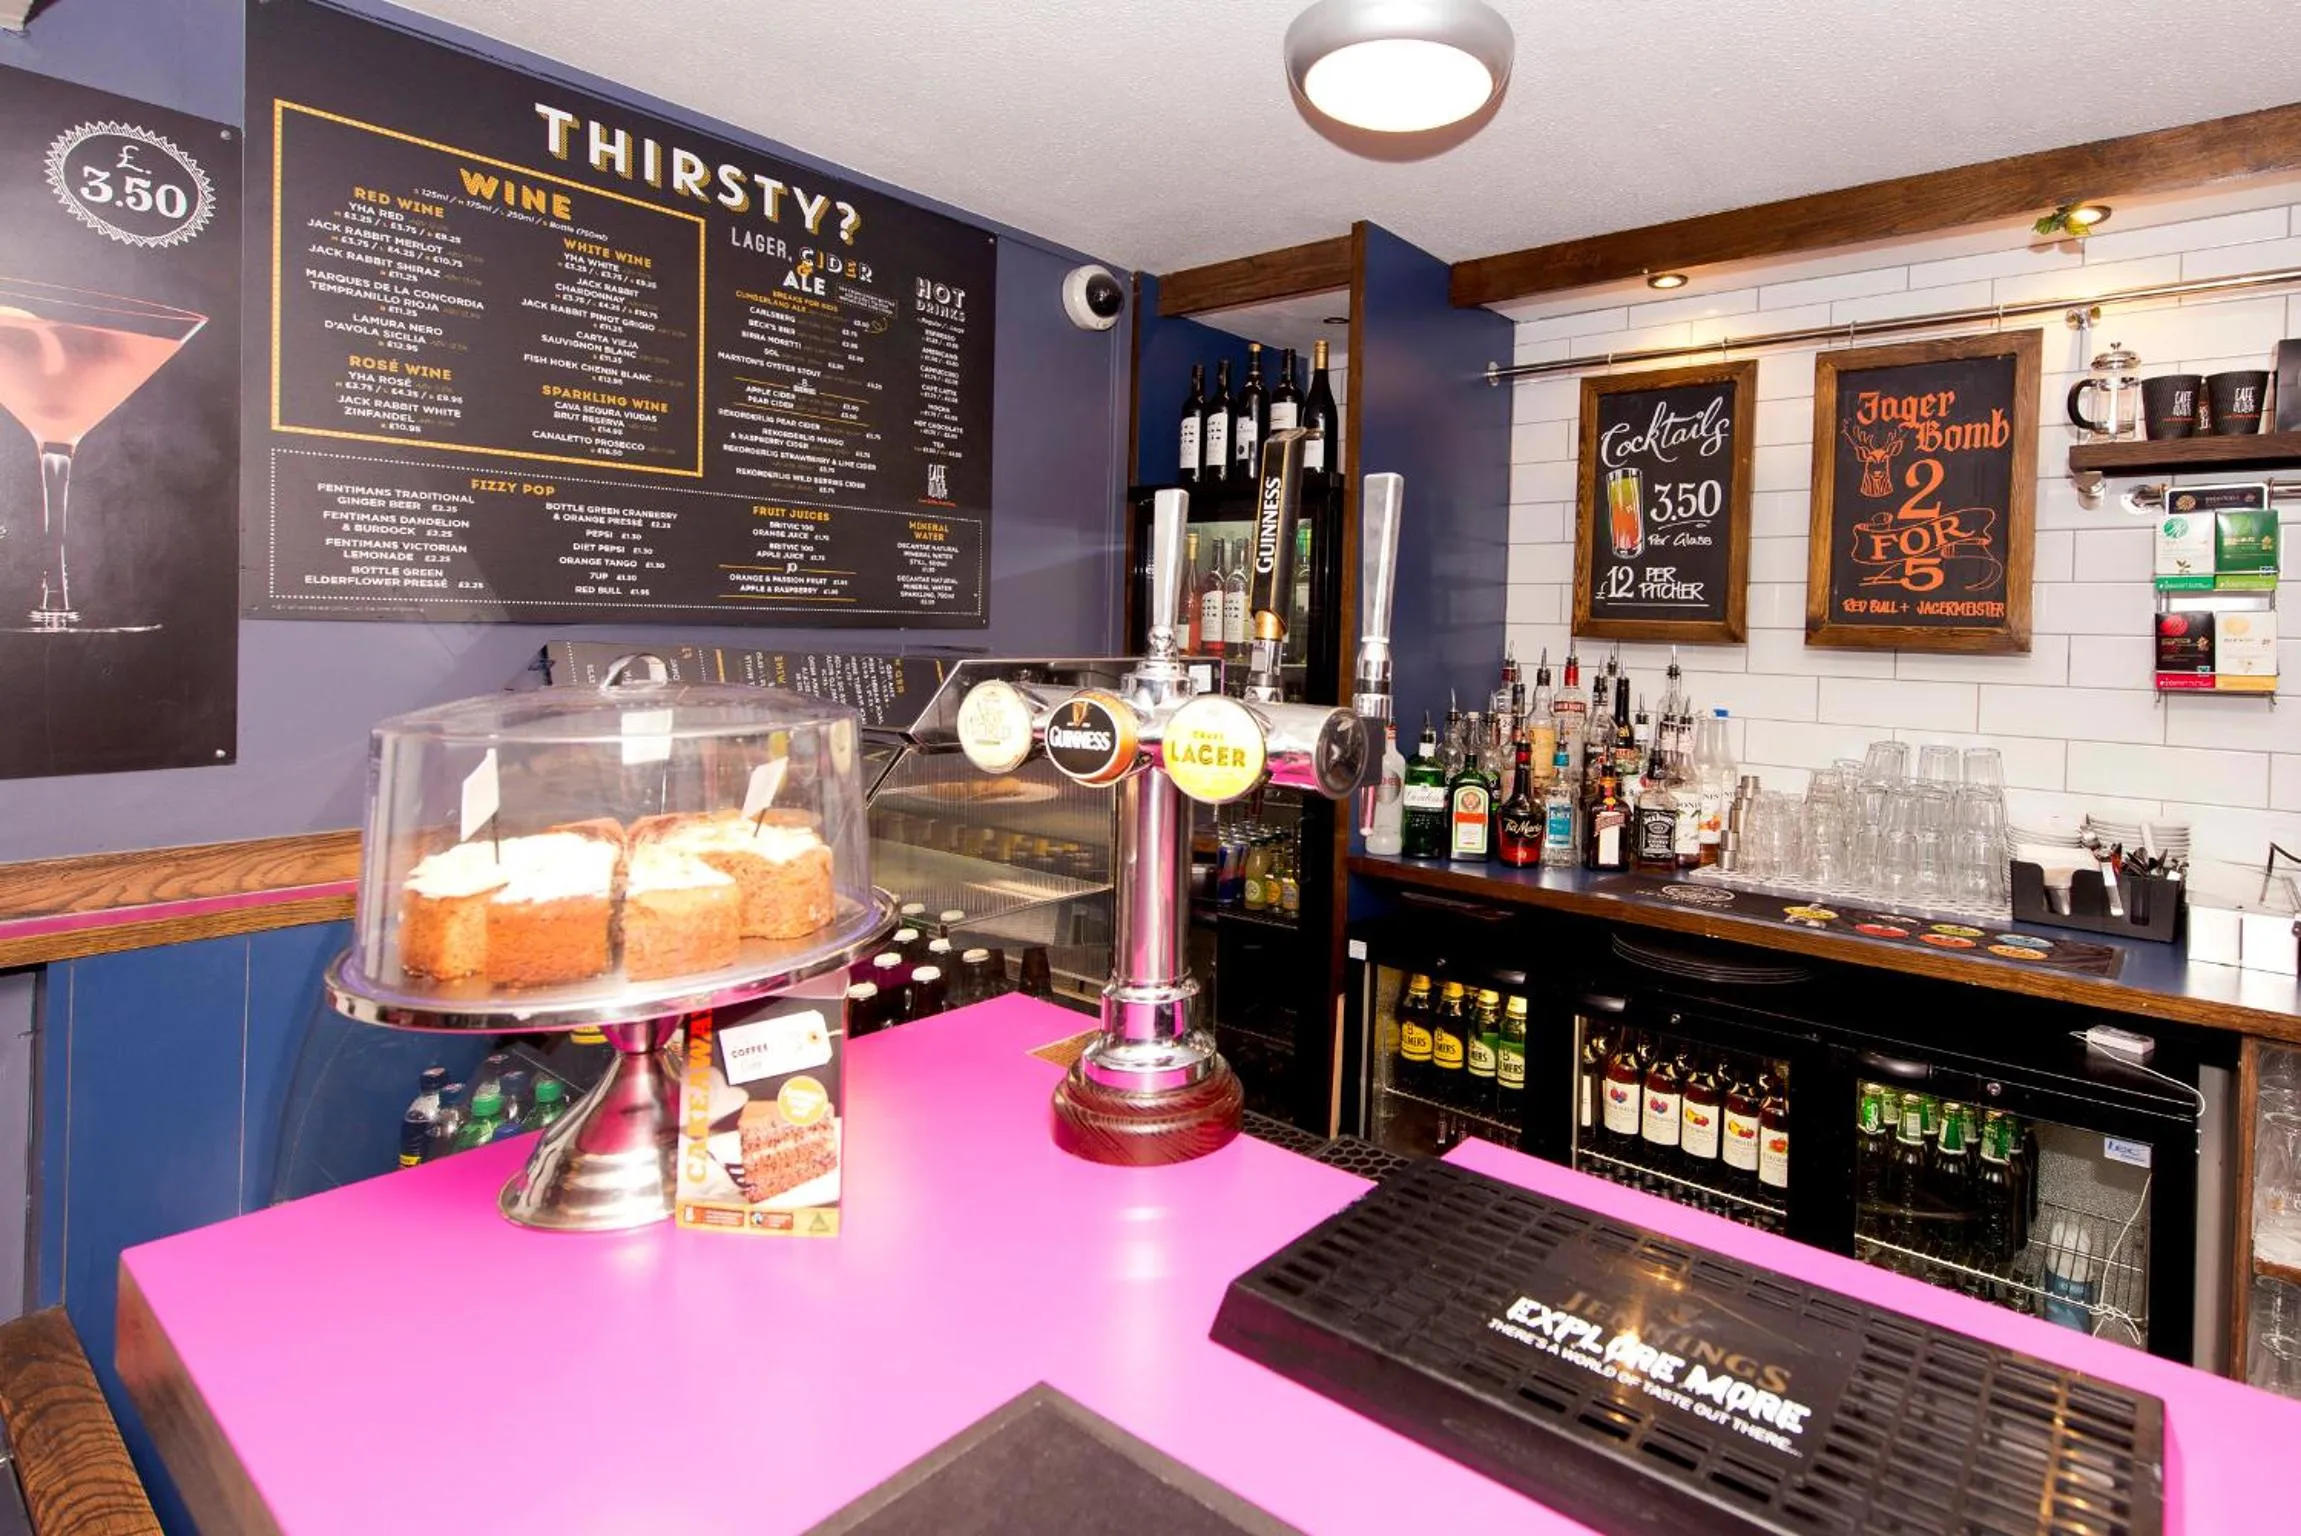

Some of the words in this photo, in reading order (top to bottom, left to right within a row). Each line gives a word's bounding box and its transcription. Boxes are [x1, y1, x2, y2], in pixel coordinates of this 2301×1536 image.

[116, 145, 152, 174] £
[534, 102, 862, 246] THIRSTY?
[80, 165, 187, 219] 3.50
[459, 168, 572, 221] WINE
[354, 186, 390, 205] RED
[397, 197, 445, 218] WINE
[349, 202, 375, 215] YHA
[379, 208, 404, 222] RED
[307, 218, 341, 233] JACK
[345, 226, 392, 243] RABBIT
[395, 236, 443, 254] MERLOT
[308, 244, 344, 258] JACK
[346, 251, 393, 268] RABBIT
[397, 262, 441, 278] SHIRAZ
[563, 238, 610, 259] WHITE
[615, 249, 652, 268] WINE
[730, 226, 793, 262] LAGER,
[800, 246, 873, 283] CIDER
[588, 258, 620, 273] WHITE
[306, 268, 370, 288] MARQUES
[374, 281, 391, 292] DE
[394, 284, 410, 296] LA
[414, 289, 484, 310] CONCORDIA
[577, 278, 601, 290] JACK
[604, 283, 640, 297] RABBIT
[782, 269, 827, 296] ALE
[309, 280, 400, 305] TEMPRANILLO
[403, 298, 440, 312] RIOJA
[555, 282, 625, 304] CHARDONNAY
[915, 276, 966, 309] HOT
[521, 299, 548, 311] JACK
[550, 303, 587, 318] RABBIT
[590, 311, 619, 324] PINOT
[622, 317, 655, 332] GRIGIO
[749, 306, 796, 323] CARLSBERG
[915, 300, 966, 322] DRINKS
[352, 313, 406, 330] LAMURA
[409, 323, 443, 336] NERO
[383, 329, 426, 344] SICILIA
[576, 331, 609, 344] CARTA
[541, 334, 602, 353] SAUVIGNON
[604, 346, 637, 359] BLANC
[764, 348, 779, 357] SOL
[349, 355, 399, 373] ROSÉ
[404, 363, 452, 381] WINE
[524, 353, 548, 365] FISH
[621, 369, 653, 382] BLANC
[797, 367, 821, 377] STOUT
[349, 371, 376, 383] YHA
[379, 375, 412, 388] ROSÉ
[541, 384, 628, 407] SPARKLING
[632, 397, 669, 413] WINE
[746, 386, 770, 395] APPLE
[773, 390, 795, 400] CIDER
[337, 395, 371, 406] JACK
[374, 399, 419, 413] RABBIT
[422, 405, 461, 419] WHITE
[344, 406, 415, 423] ZINFANDEL
[554, 401, 581, 412] CAVA
[583, 404, 622, 417] SEGURA
[1856, 390, 1955, 427] Jager
[553, 410, 580, 422] BRUT
[582, 414, 625, 428] RESERVA
[1601, 395, 1730, 469] Cocktails
[1914, 408, 2010, 453] Bomb
[532, 430, 592, 445] CANALETTO
[594, 438, 645, 452] PROSECCO
[317, 482, 392, 497] FENTIMANS
[396, 489, 475, 504] TRADITIONAL
[470, 478, 517, 494] FIZZY
[522, 484, 556, 497] POP
[1896, 459, 1945, 520] 2
[337, 497, 386, 508] GINGER
[389, 500, 421, 511] BEER
[1650, 479, 1722, 522] 3.50
[323, 510, 397, 523] FENTIMANS
[400, 516, 470, 528] DANDELION
[545, 502, 585, 513] BOTTLE
[587, 506, 620, 516] GREEN
[622, 508, 678, 520] CRANBERRY
[553, 513, 561, 521] &
[563, 513, 605, 525] ORANGE
[752, 506, 787, 517] FRUIT
[790, 510, 831, 521] JUICES
[342, 523, 350, 532] &
[354, 524, 416, 536] BURDOCK
[586, 529, 613, 539] PEPSI
[752, 529, 786, 538] ORANGE
[909, 521, 949, 533] MINERAL
[1256, 476, 1282, 574] GUINNESS
[325, 537, 399, 550] FENTIMANS
[402, 542, 468, 553] VICTORIAN
[914, 531, 944, 541] WATER
[1673, 532, 1712, 547] Glass
[1870, 516, 1976, 560] FOR
[343, 550, 414, 561] LEMONADE
[573, 543, 596, 552] DIET
[598, 544, 625, 554] PEPSI
[351, 566, 400, 576] BOTTLE
[403, 567, 443, 577] GREEN
[559, 556, 603, 566] ORANGE
[604, 558, 638, 568] TANGO
[304, 575, 400, 586] ELDERFLOWER
[589, 572, 609, 580] 7UP
[1645, 567, 1676, 582] PER
[575, 586, 595, 594] RED
[598, 587, 622, 595] BULL
[1639, 582, 1704, 600] PITCHER
[1870, 599, 1898, 612] BULL
[1917, 599, 2005, 618] JAGERMEISTER
[1049, 725, 1111, 751] GUINNESS
[731, 1043, 769, 1059] COFFEE
[1487, 1317, 1549, 1351] THERE'S
[1548, 1342, 1559, 1356] A
[1561, 1348, 1618, 1379] WORLD
[1617, 1367, 1643, 1389] OF
[1642, 1380, 1694, 1412] TASTE
[1693, 1402, 1732, 1426] OUT
[1506, 1295, 1686, 1386] EXPLORE
[1678, 1364, 1813, 1436] MORE
